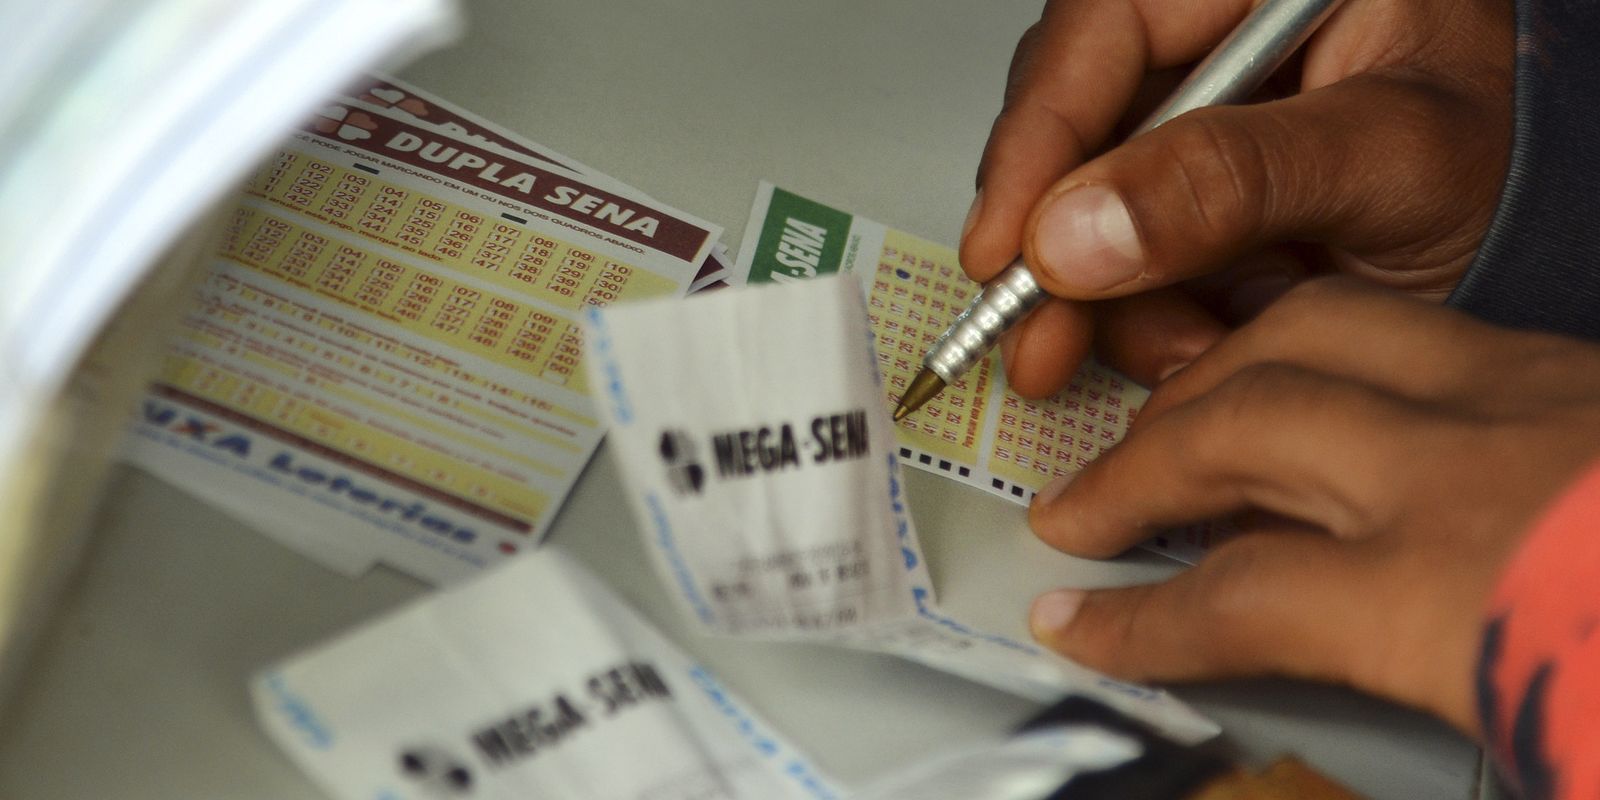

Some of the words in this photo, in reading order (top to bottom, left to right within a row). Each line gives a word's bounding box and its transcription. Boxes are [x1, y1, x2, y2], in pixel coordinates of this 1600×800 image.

[312, 138, 341, 151] PODE
[343, 149, 380, 164] JOGAR
[381, 160, 442, 184] MARCANDO
[443, 181, 460, 191] EM
[461, 187, 480, 197] UM
[480, 194, 496, 204] OU
[498, 200, 521, 212] NOS
[523, 208, 549, 221] DOIS
[551, 218, 604, 240] QUADROS
[385, 132, 537, 194] DUPLA
[544, 185, 660, 238] SENA
